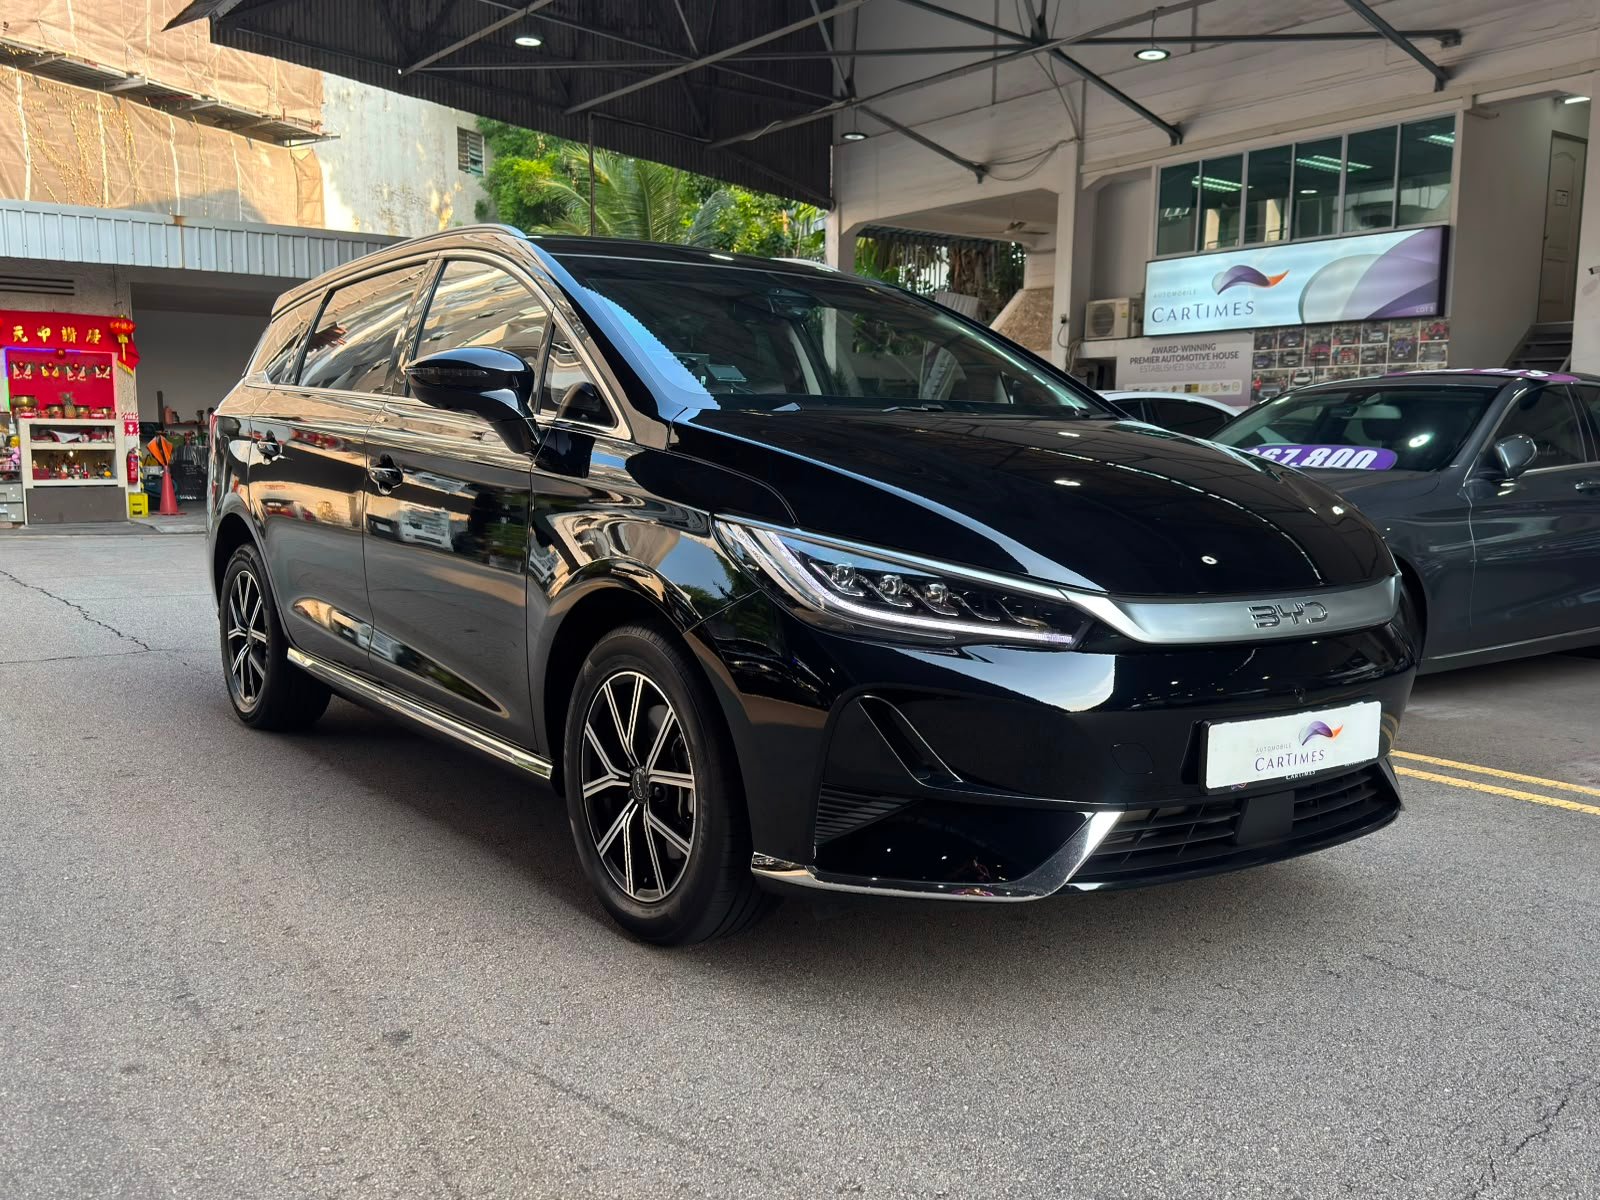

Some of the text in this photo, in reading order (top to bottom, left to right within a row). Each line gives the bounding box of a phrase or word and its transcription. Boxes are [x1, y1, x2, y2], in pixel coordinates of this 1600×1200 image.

[1153, 289, 1197, 299] AUTOMOBILE
[1151, 300, 1255, 323] CARTIMES
[1151, 343, 1216, 355] AWARD-WINNING
[1129, 351, 1240, 365] PREMIER AUTOMOTIVE HOUSE
[1140, 361, 1227, 373] ESTABLISHED SINCE 2001
[1248, 601, 1329, 629] BYD
[1255, 743, 1292, 753] AUTOMOBILE
[1254, 749, 1325, 772] CARTIMES
